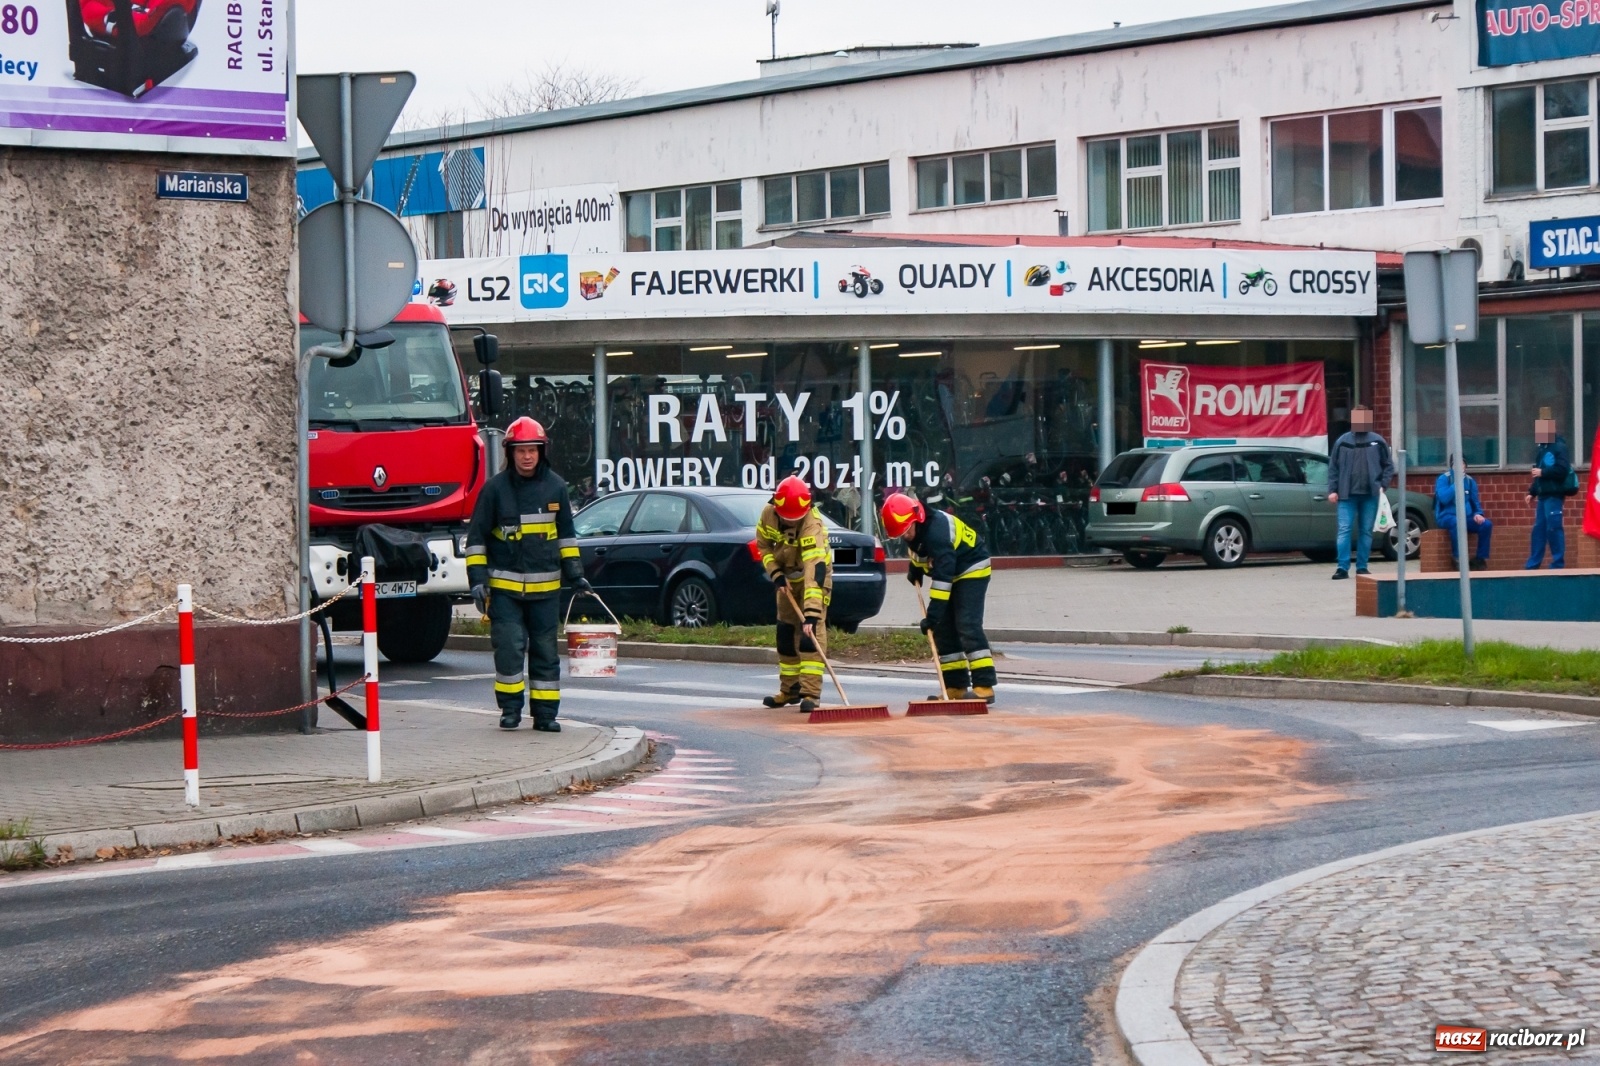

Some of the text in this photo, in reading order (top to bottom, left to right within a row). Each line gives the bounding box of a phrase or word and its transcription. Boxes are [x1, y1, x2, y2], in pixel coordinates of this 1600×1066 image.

[1, 4, 38, 35] 80
[227, 0, 242, 70] RACIB
[257, 46, 273, 72] ul.
[165, 174, 242, 195] Mariańska
[491, 207, 509, 232] Do
[511, 199, 572, 236] wynajęcia
[467, 276, 510, 302] LS2
[631, 267, 804, 296] FAJERWERKI
[898, 263, 996, 295] QUADY
[1087, 266, 1215, 293] AKCESORIA
[1289, 269, 1371, 294] CROSSY
[1193, 383, 1314, 418] ROMET
[648, 390, 907, 443] RATY 1%
[1151, 416, 1187, 428] ROMET
[596, 456, 723, 491] ROWERY
[741, 455, 776, 490] od
